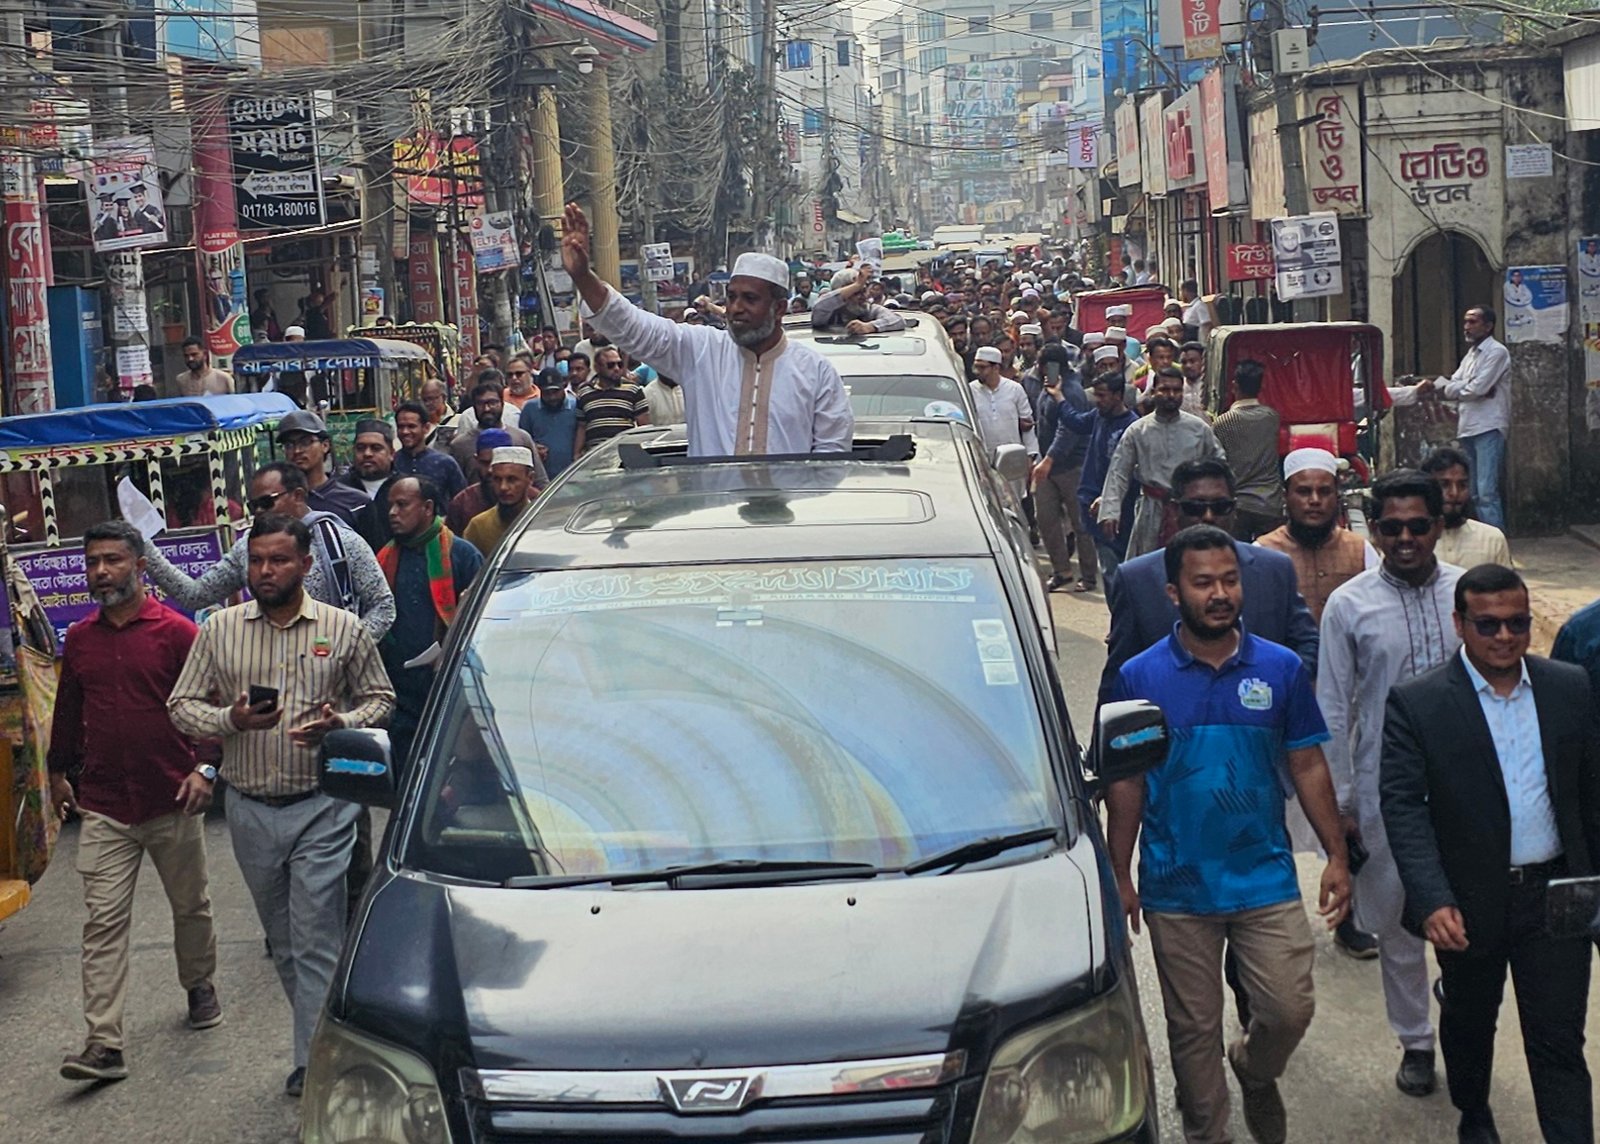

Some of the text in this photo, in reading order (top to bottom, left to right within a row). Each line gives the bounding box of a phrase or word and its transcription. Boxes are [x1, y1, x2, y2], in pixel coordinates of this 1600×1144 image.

[1312, 185, 1359, 205] ভবন
[1411, 183, 1472, 206] ভবন
[242, 202, 317, 217] 01718-180016
